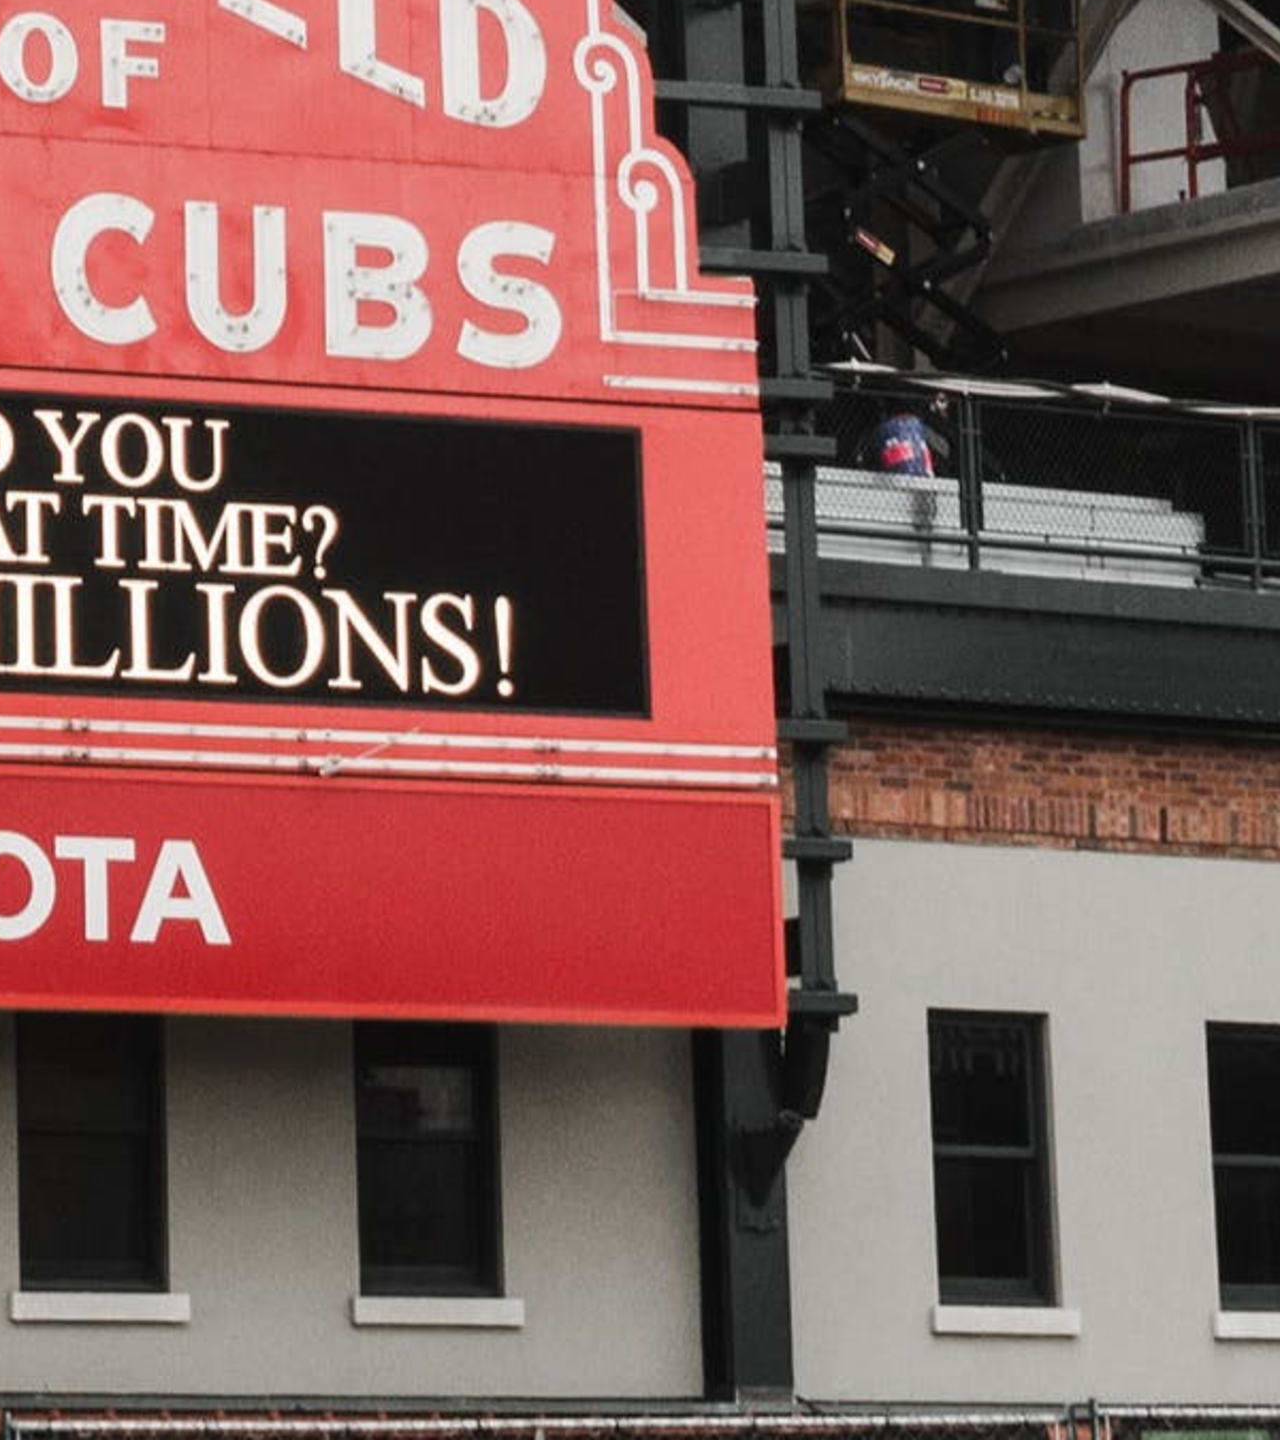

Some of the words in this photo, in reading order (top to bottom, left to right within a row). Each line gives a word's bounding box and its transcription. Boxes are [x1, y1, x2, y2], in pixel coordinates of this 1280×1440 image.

[50, 191, 564, 371] CUBS
[33, 409, 230, 492] YOU
[81, 494, 339, 580] TIME?
